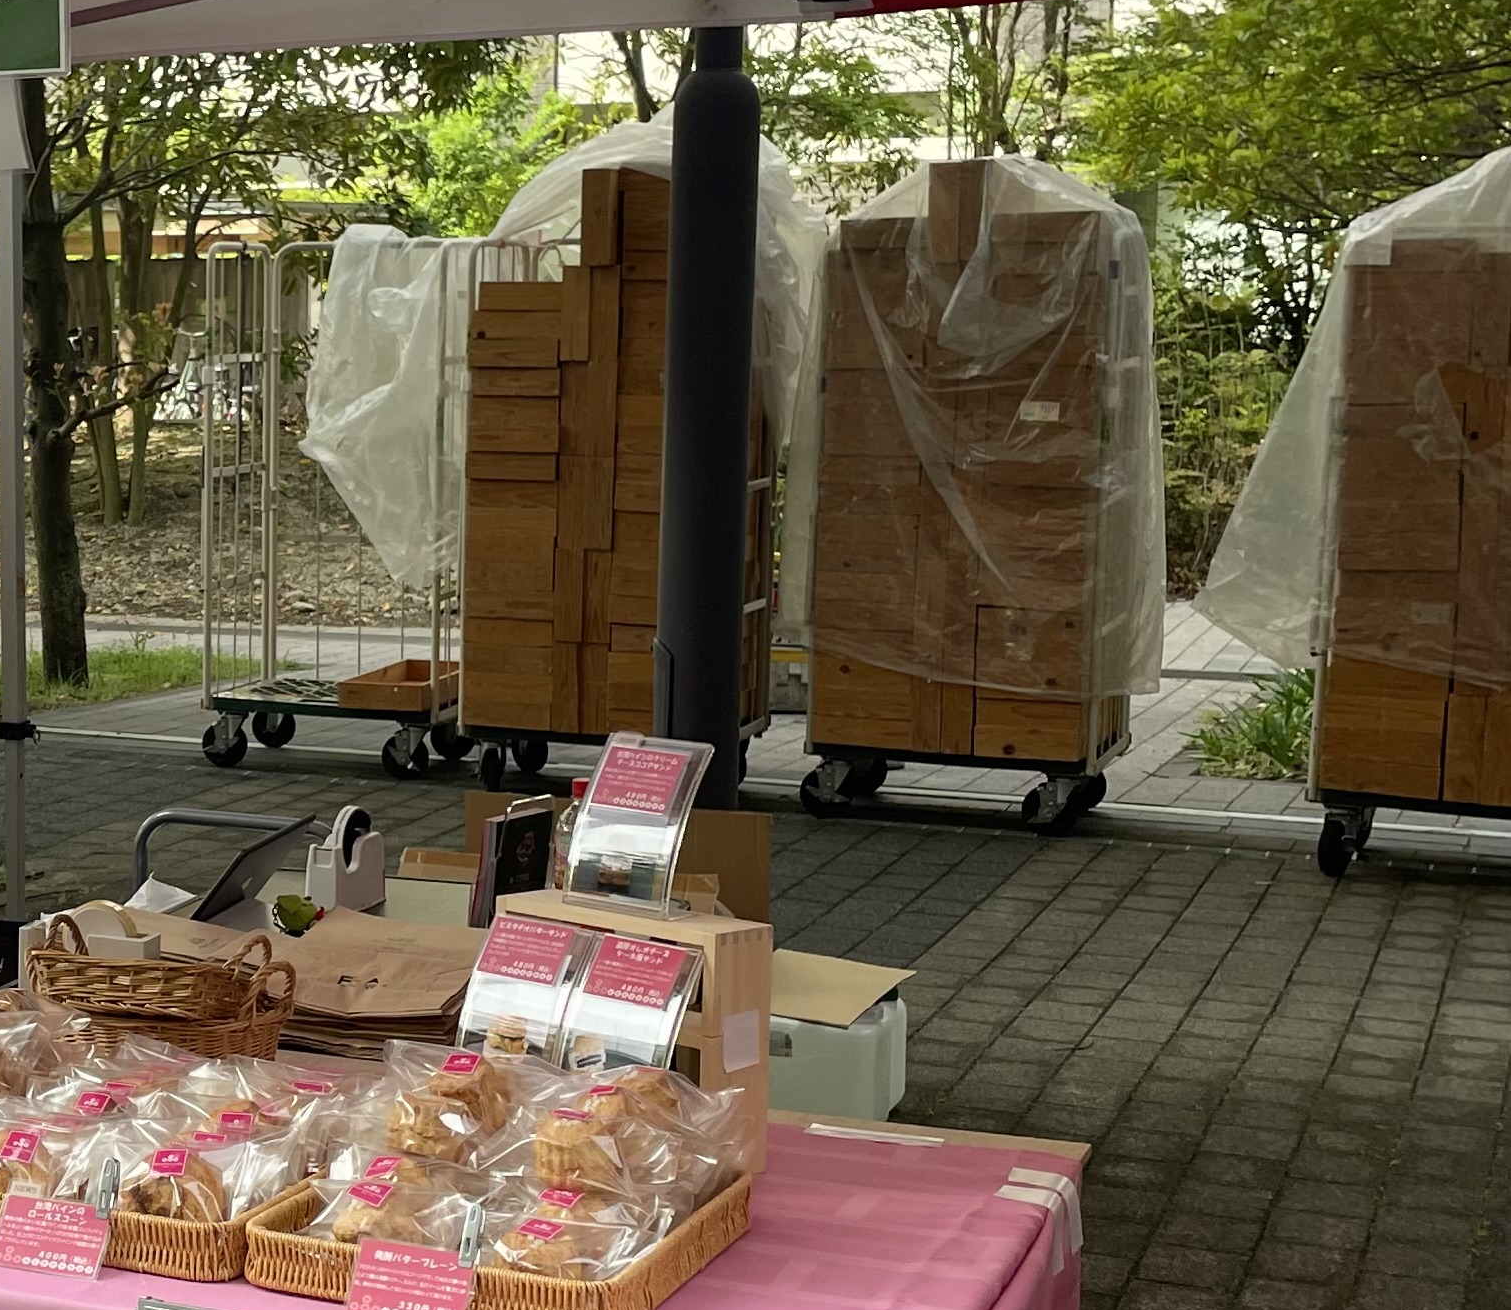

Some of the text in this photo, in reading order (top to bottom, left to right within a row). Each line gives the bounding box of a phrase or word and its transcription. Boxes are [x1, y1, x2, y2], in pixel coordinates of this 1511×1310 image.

[34, 1200, 86, 1216] 台湾パインの
[27, 1209, 87, 1226] ロールスコーン
